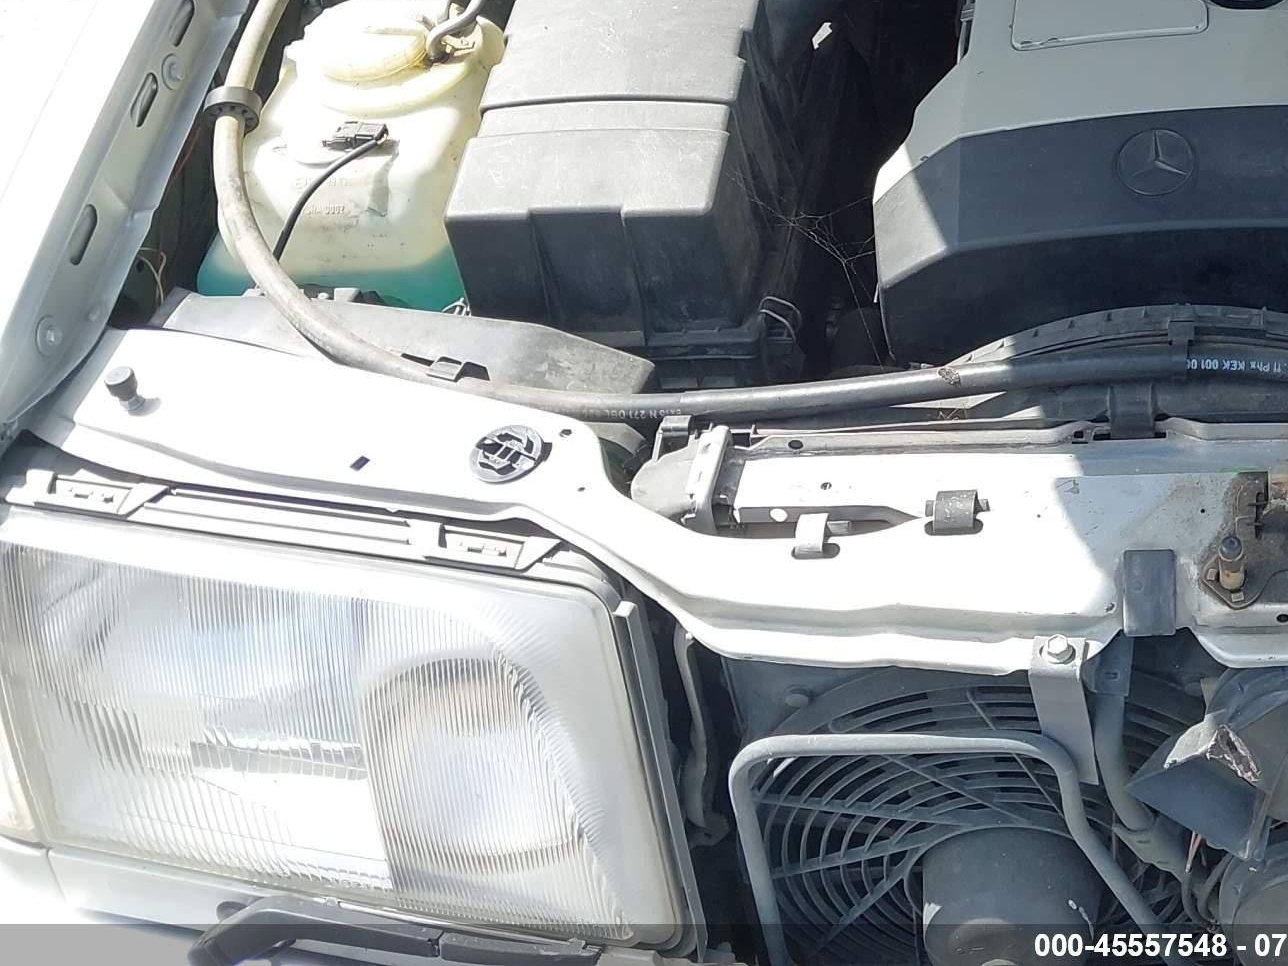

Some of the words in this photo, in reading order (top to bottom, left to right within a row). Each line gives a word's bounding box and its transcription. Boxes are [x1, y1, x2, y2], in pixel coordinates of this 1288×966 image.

[1201, 358, 1219, 370] 001
[1222, 359, 1246, 371] KEK
[629, 409, 646, 420] 271
